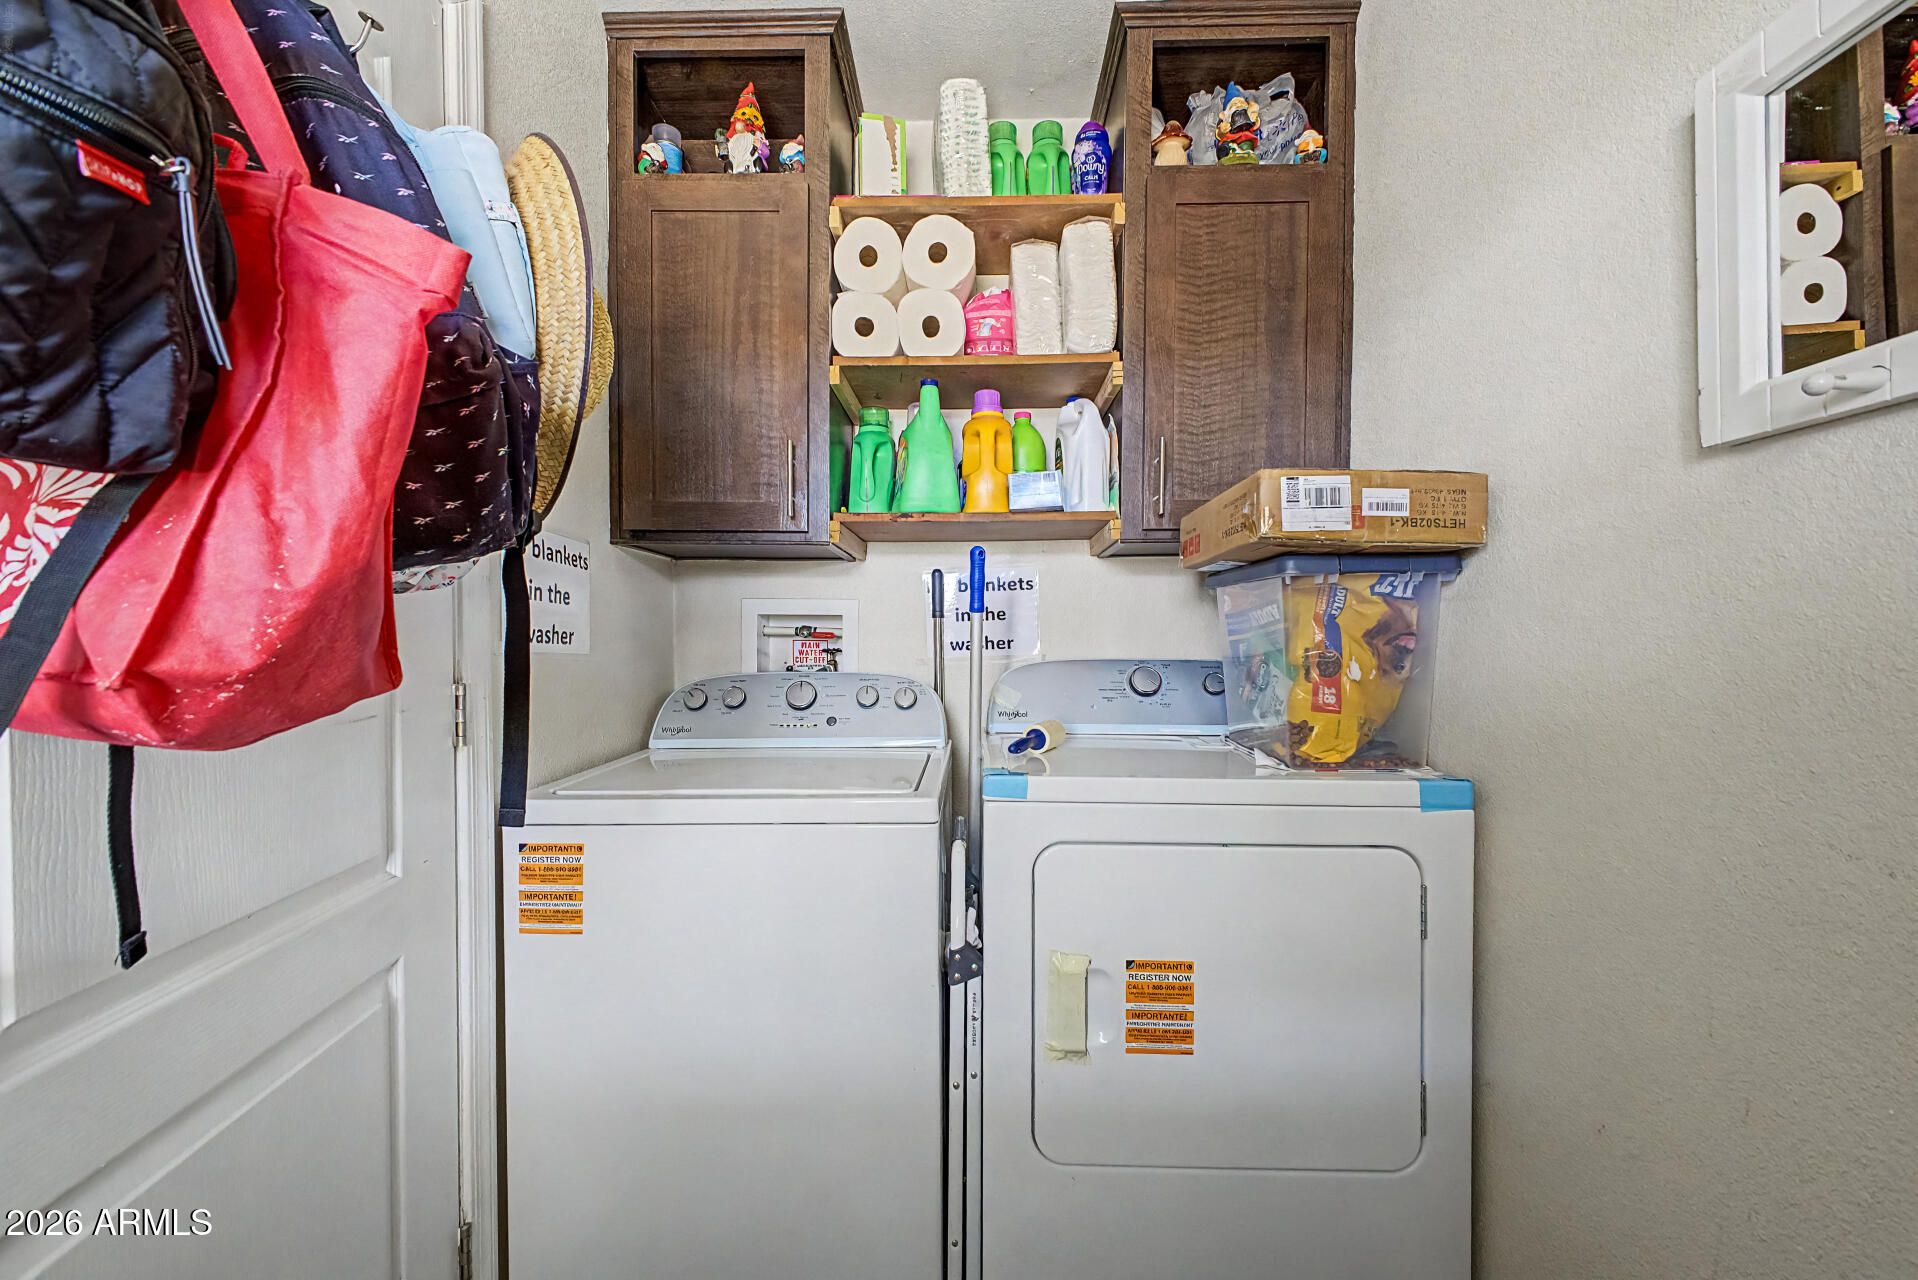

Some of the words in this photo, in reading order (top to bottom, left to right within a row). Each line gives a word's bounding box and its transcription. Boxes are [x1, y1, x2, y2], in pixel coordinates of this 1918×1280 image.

[1077, 162, 1105, 175] Downy
[1390, 517, 1466, 529] HETS02BK-1
[531, 538, 589, 571] blankets
[957, 576, 1034, 593] bnkets
[529, 578, 543, 602] in
[547, 583, 571, 606] the
[955, 607, 971, 622] in
[981, 606, 1007, 622] he
[801, 641, 821, 649] MAIN
[949, 635, 1014, 651] waher
[795, 656, 826, 664] CUT-OFF
[562, 856, 582, 864] NOW
[1128, 973, 1170, 982] REGISTER
[1171, 974, 1192, 982] NOW
